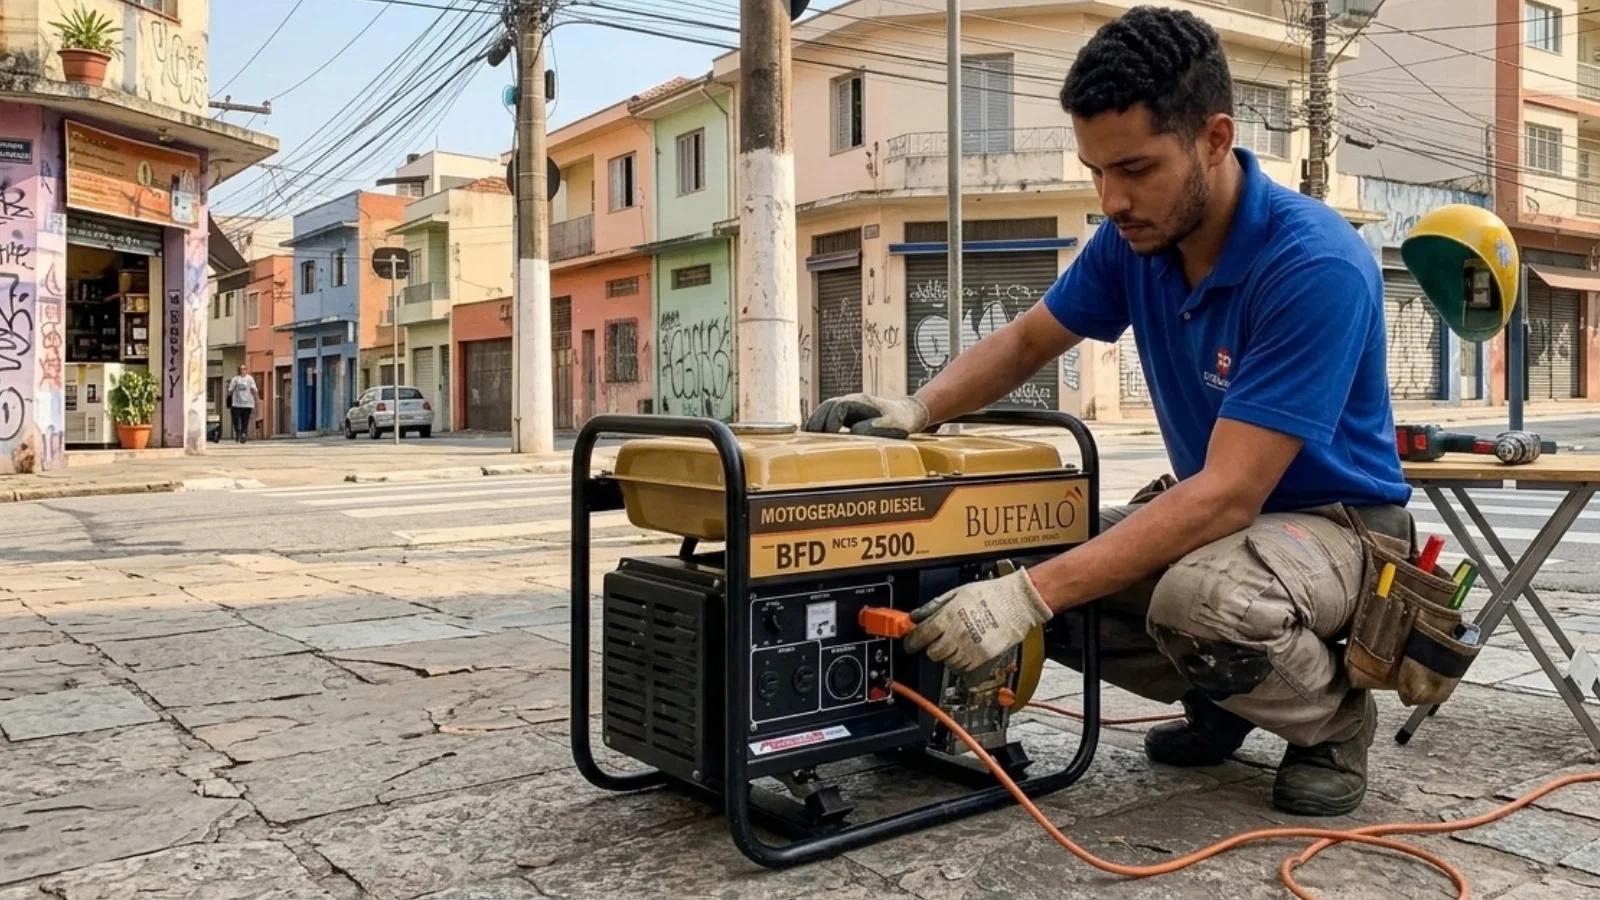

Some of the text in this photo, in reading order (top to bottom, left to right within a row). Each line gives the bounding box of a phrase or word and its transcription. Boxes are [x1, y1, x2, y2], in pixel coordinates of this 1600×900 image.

[761, 496, 926, 525] MOTOGERADOR DIESEL
[965, 500, 1076, 538] BUFFALO
[776, 540, 827, 570] BFD
[861, 532, 916, 561] 2500
